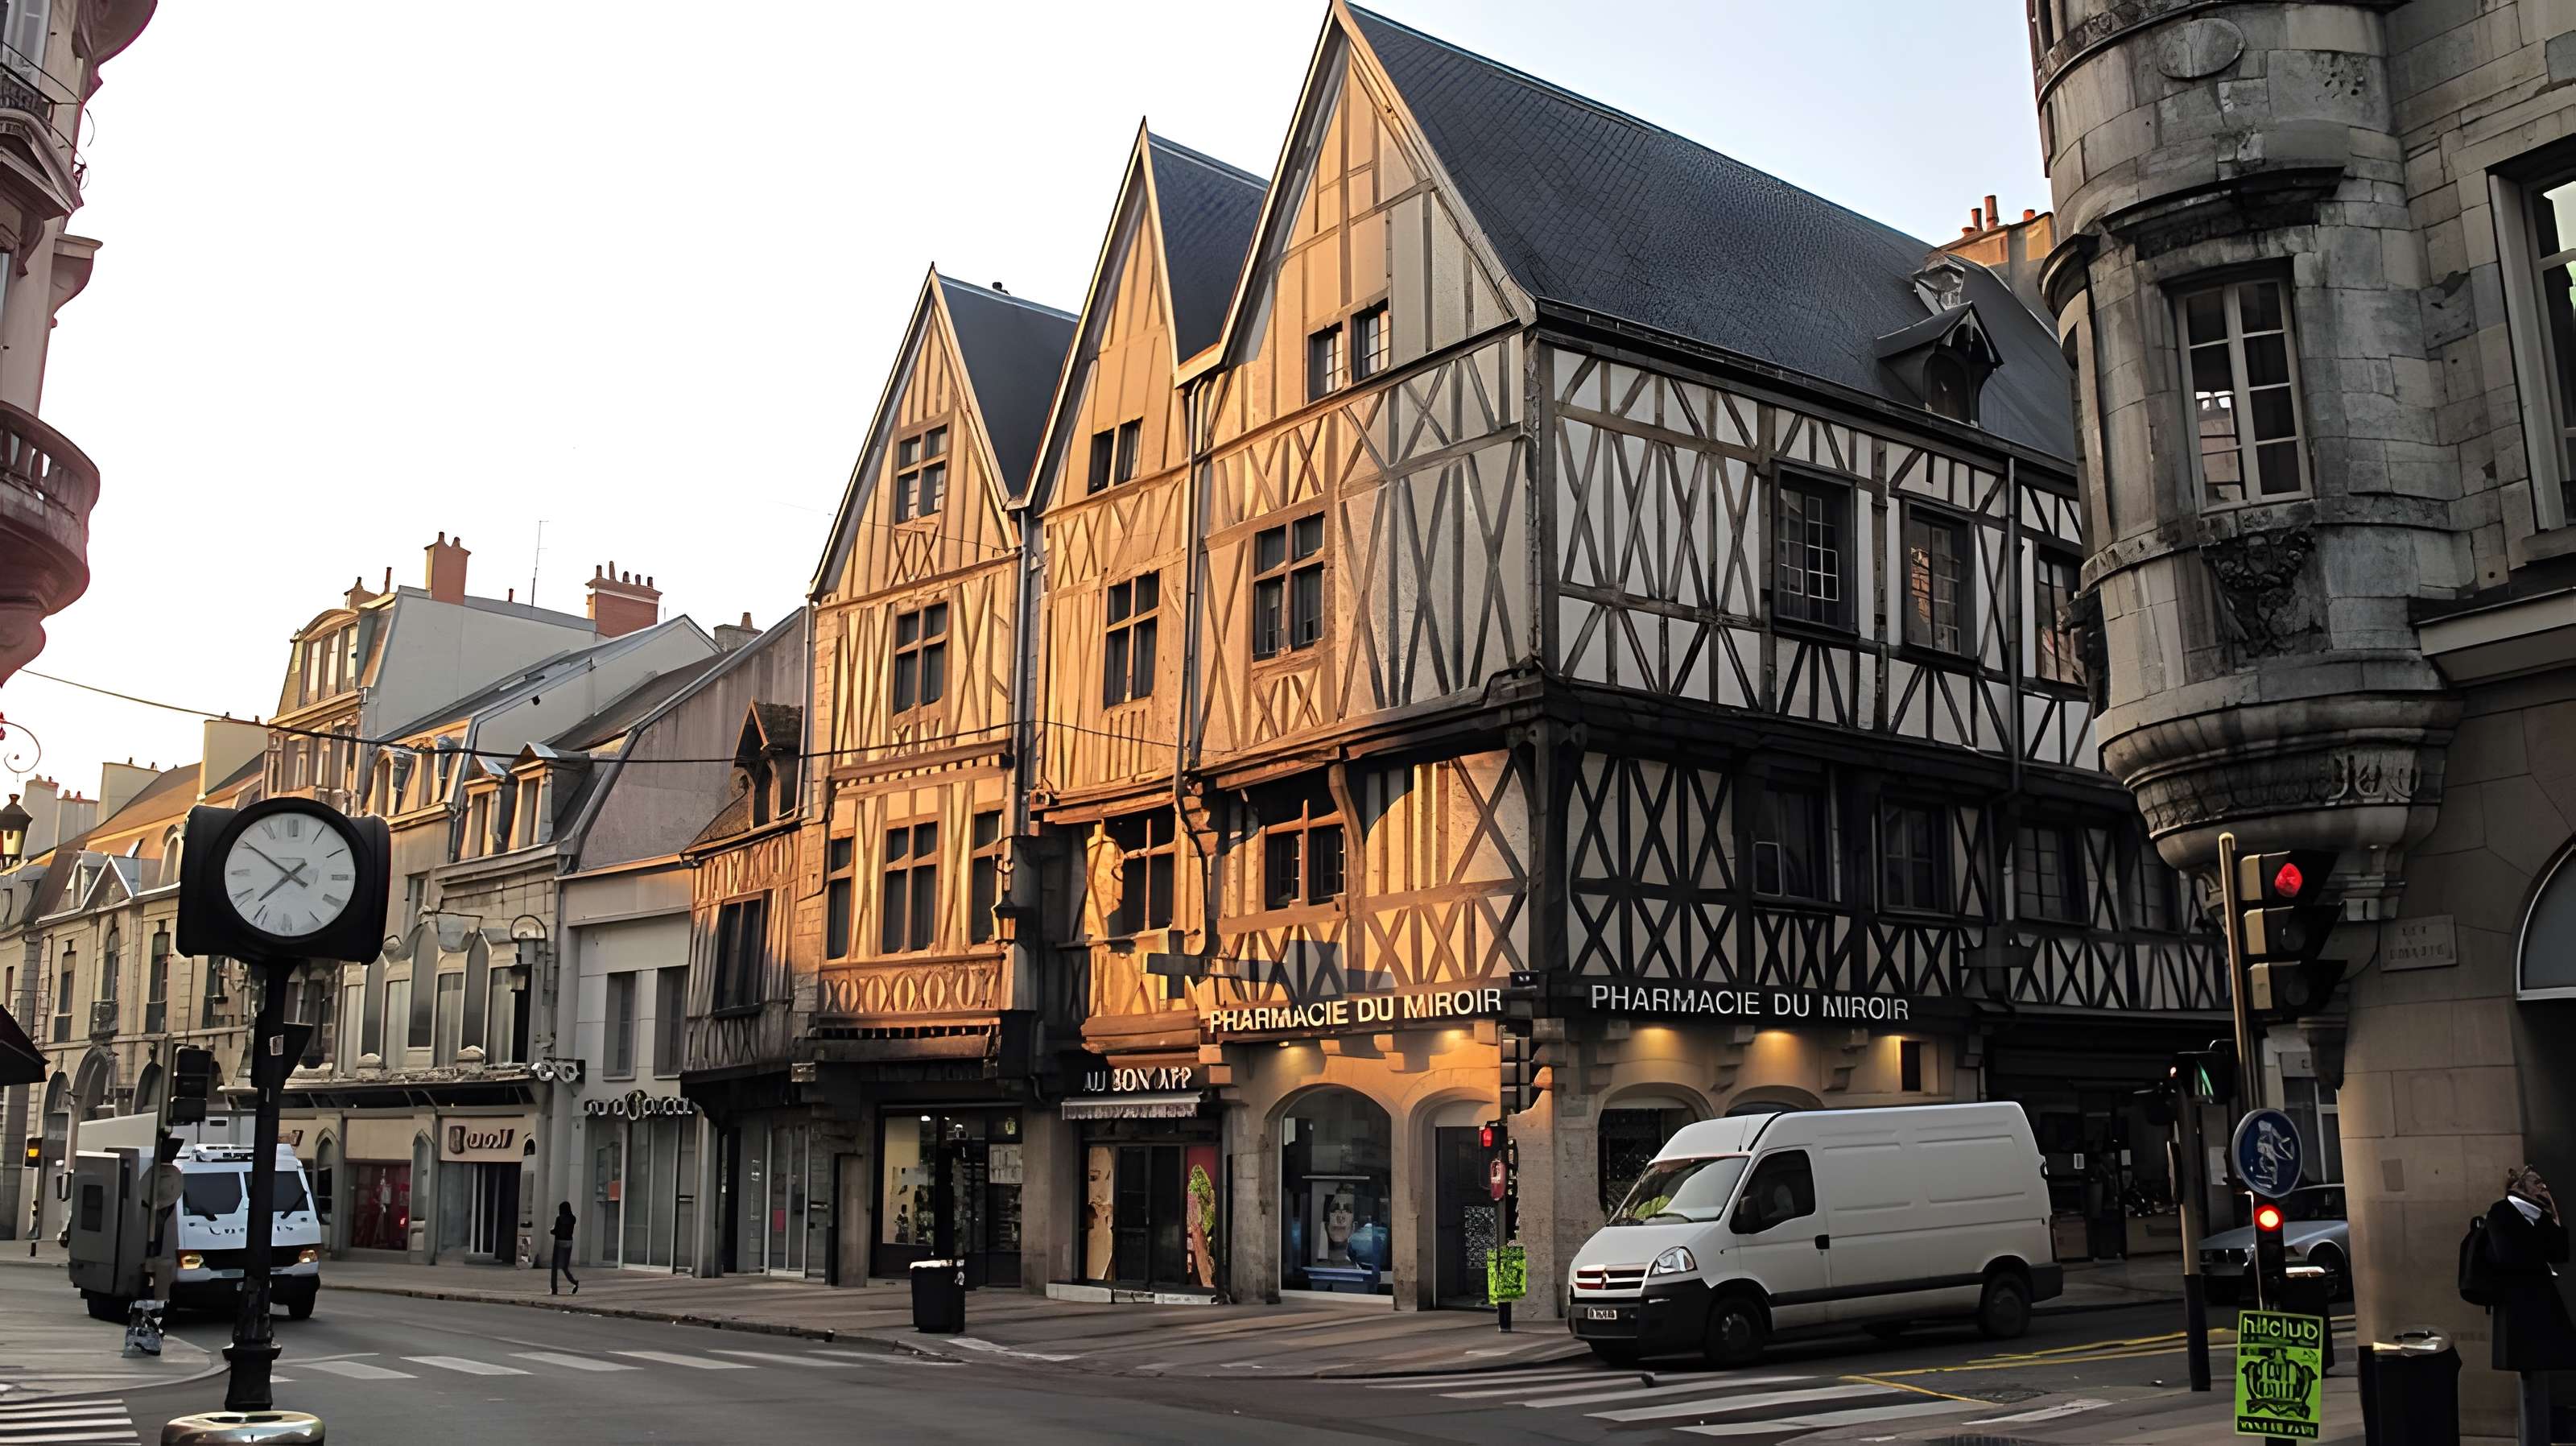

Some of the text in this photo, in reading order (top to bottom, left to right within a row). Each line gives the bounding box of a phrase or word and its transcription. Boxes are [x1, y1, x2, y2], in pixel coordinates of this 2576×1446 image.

[1209, 989, 1502, 1034] PHARMACIE DU MIROIR
[1591, 985, 1909, 1020] PHARMACIE DU MIROIR
